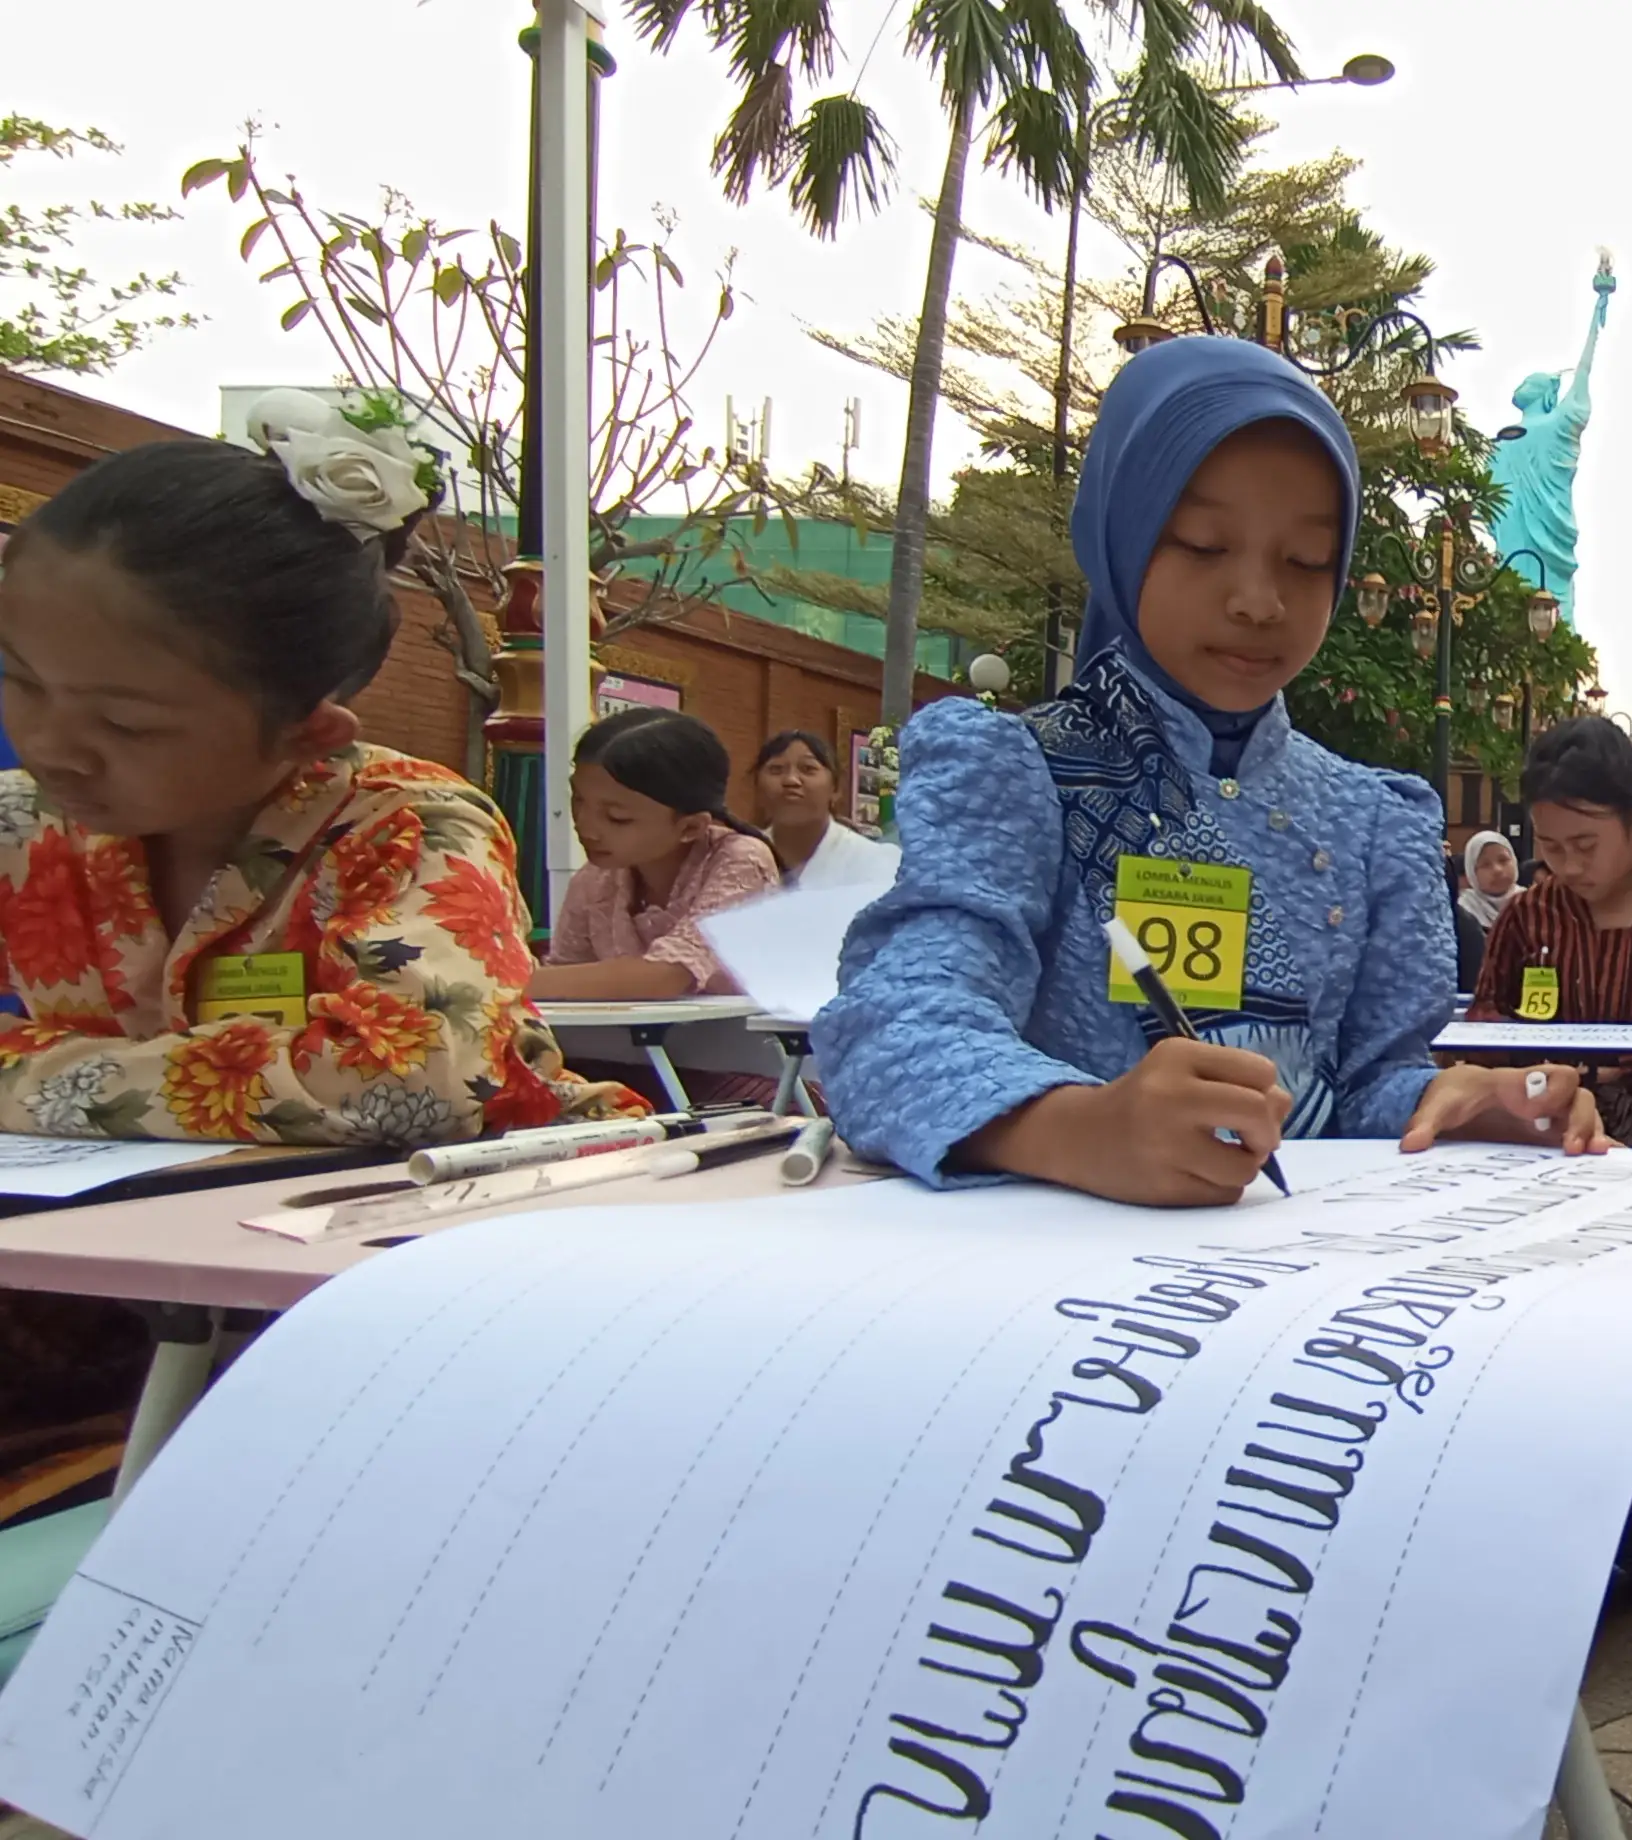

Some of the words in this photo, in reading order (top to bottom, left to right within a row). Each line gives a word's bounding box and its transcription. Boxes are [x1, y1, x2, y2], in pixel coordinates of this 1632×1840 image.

[1136, 869, 1179, 885] LOMBA
[1143, 888, 1189, 902] AKSARA
[1137, 916, 1222, 981] 98
[1525, 991, 1552, 1015] 65
